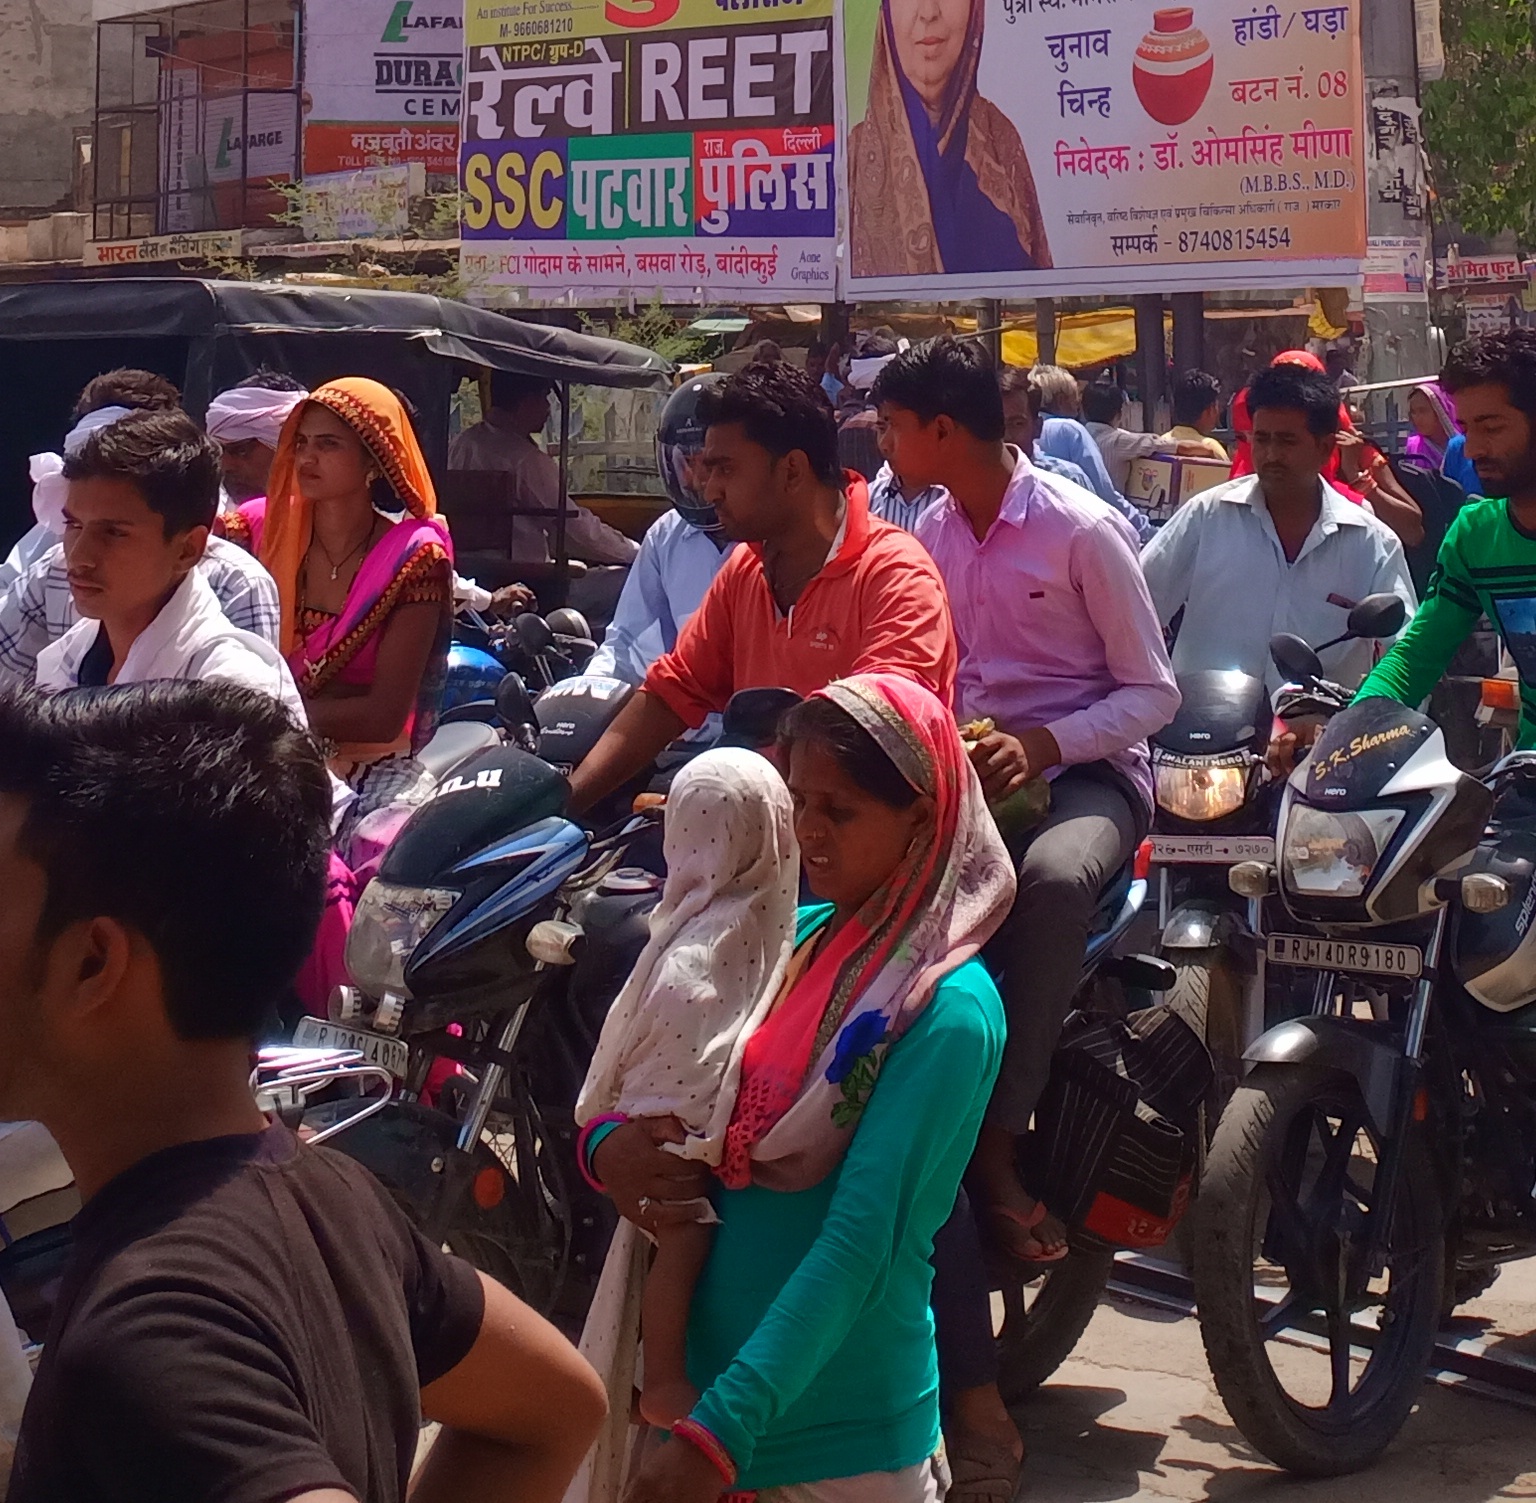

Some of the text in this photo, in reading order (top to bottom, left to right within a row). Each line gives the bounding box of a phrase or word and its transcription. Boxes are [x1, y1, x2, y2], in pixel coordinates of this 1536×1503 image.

[402, 16, 463, 29] LAFA
[477, 7, 488, 19] An
[522, 2, 536, 15] For
[1301, 6, 1349, 40] घड़ा
[514, 18, 573, 36] 9660681210
[1044, 29, 1112, 73] चुनाव
[641, 29, 828, 122] REET
[1057, 79, 1112, 118] चिन्ह
[1228, 77, 1279, 105] बटन
[1318, 70, 1347, 98] 08
[415, 129, 457, 152] अंदर
[783, 127, 822, 153] दिल्ली
[1053, 136, 1131, 180] निवेदक
[1192, 124, 1284, 167] ओमसिंह
[1289, 119, 1353, 160] मीणा
[465, 150, 564, 230] SSC
[571, 157, 690, 230] पटवार
[700, 138, 832, 234] पुलिस
[96, 244, 138, 262] भारत
[1110, 224, 1158, 256] सम्पर्क
[1178, 227, 1291, 253] 8740815454
[523, 247, 563, 278] गोदाम
[566, 247, 582, 275] के
[635, 253, 676, 275] बसवा
[791, 267, 830, 283] Graphics
[1212, 753, 1243, 767] HERO
